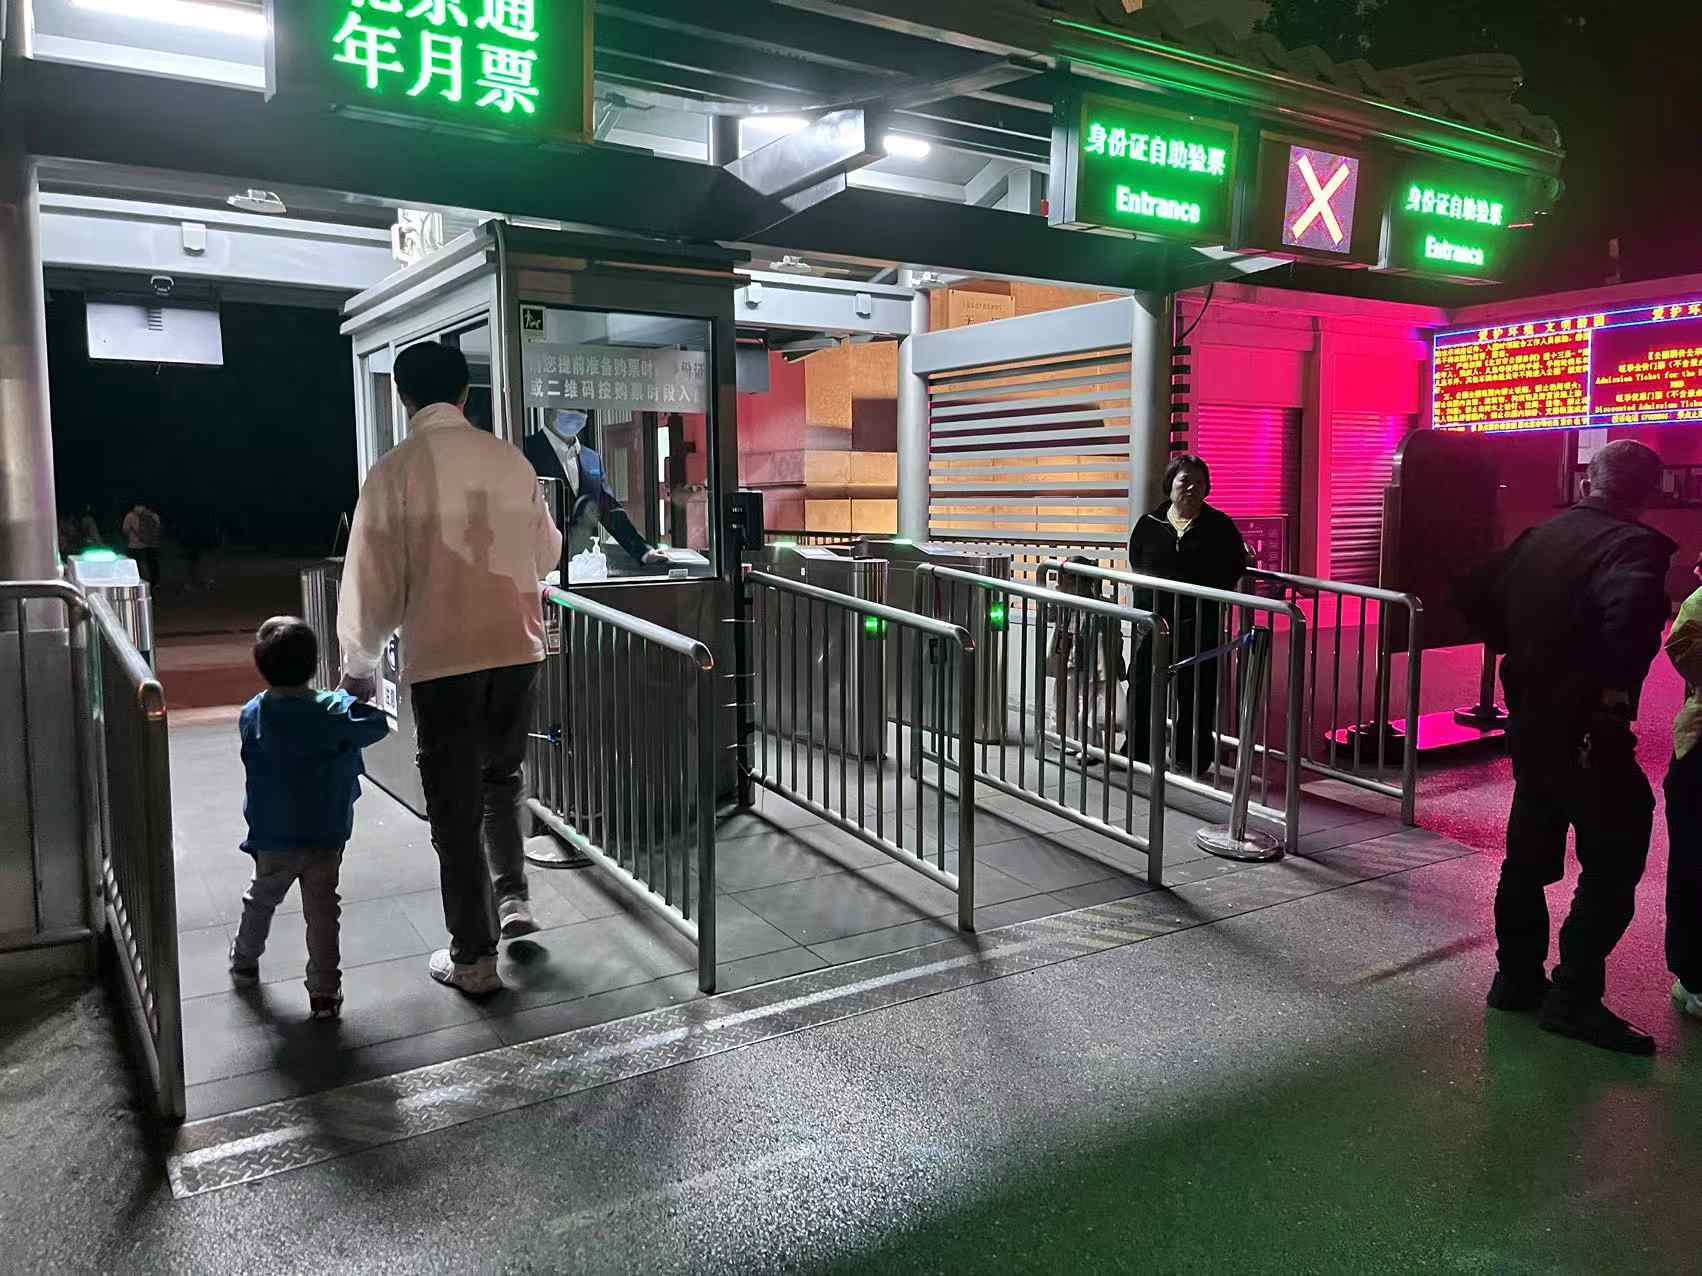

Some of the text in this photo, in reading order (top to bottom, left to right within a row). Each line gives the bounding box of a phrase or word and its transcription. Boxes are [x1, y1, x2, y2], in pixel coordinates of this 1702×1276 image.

[332, 12, 539, 113] 年月票
[1085, 122, 1226, 176] 身份证自助验票
[1116, 184, 1200, 224] Entrance
